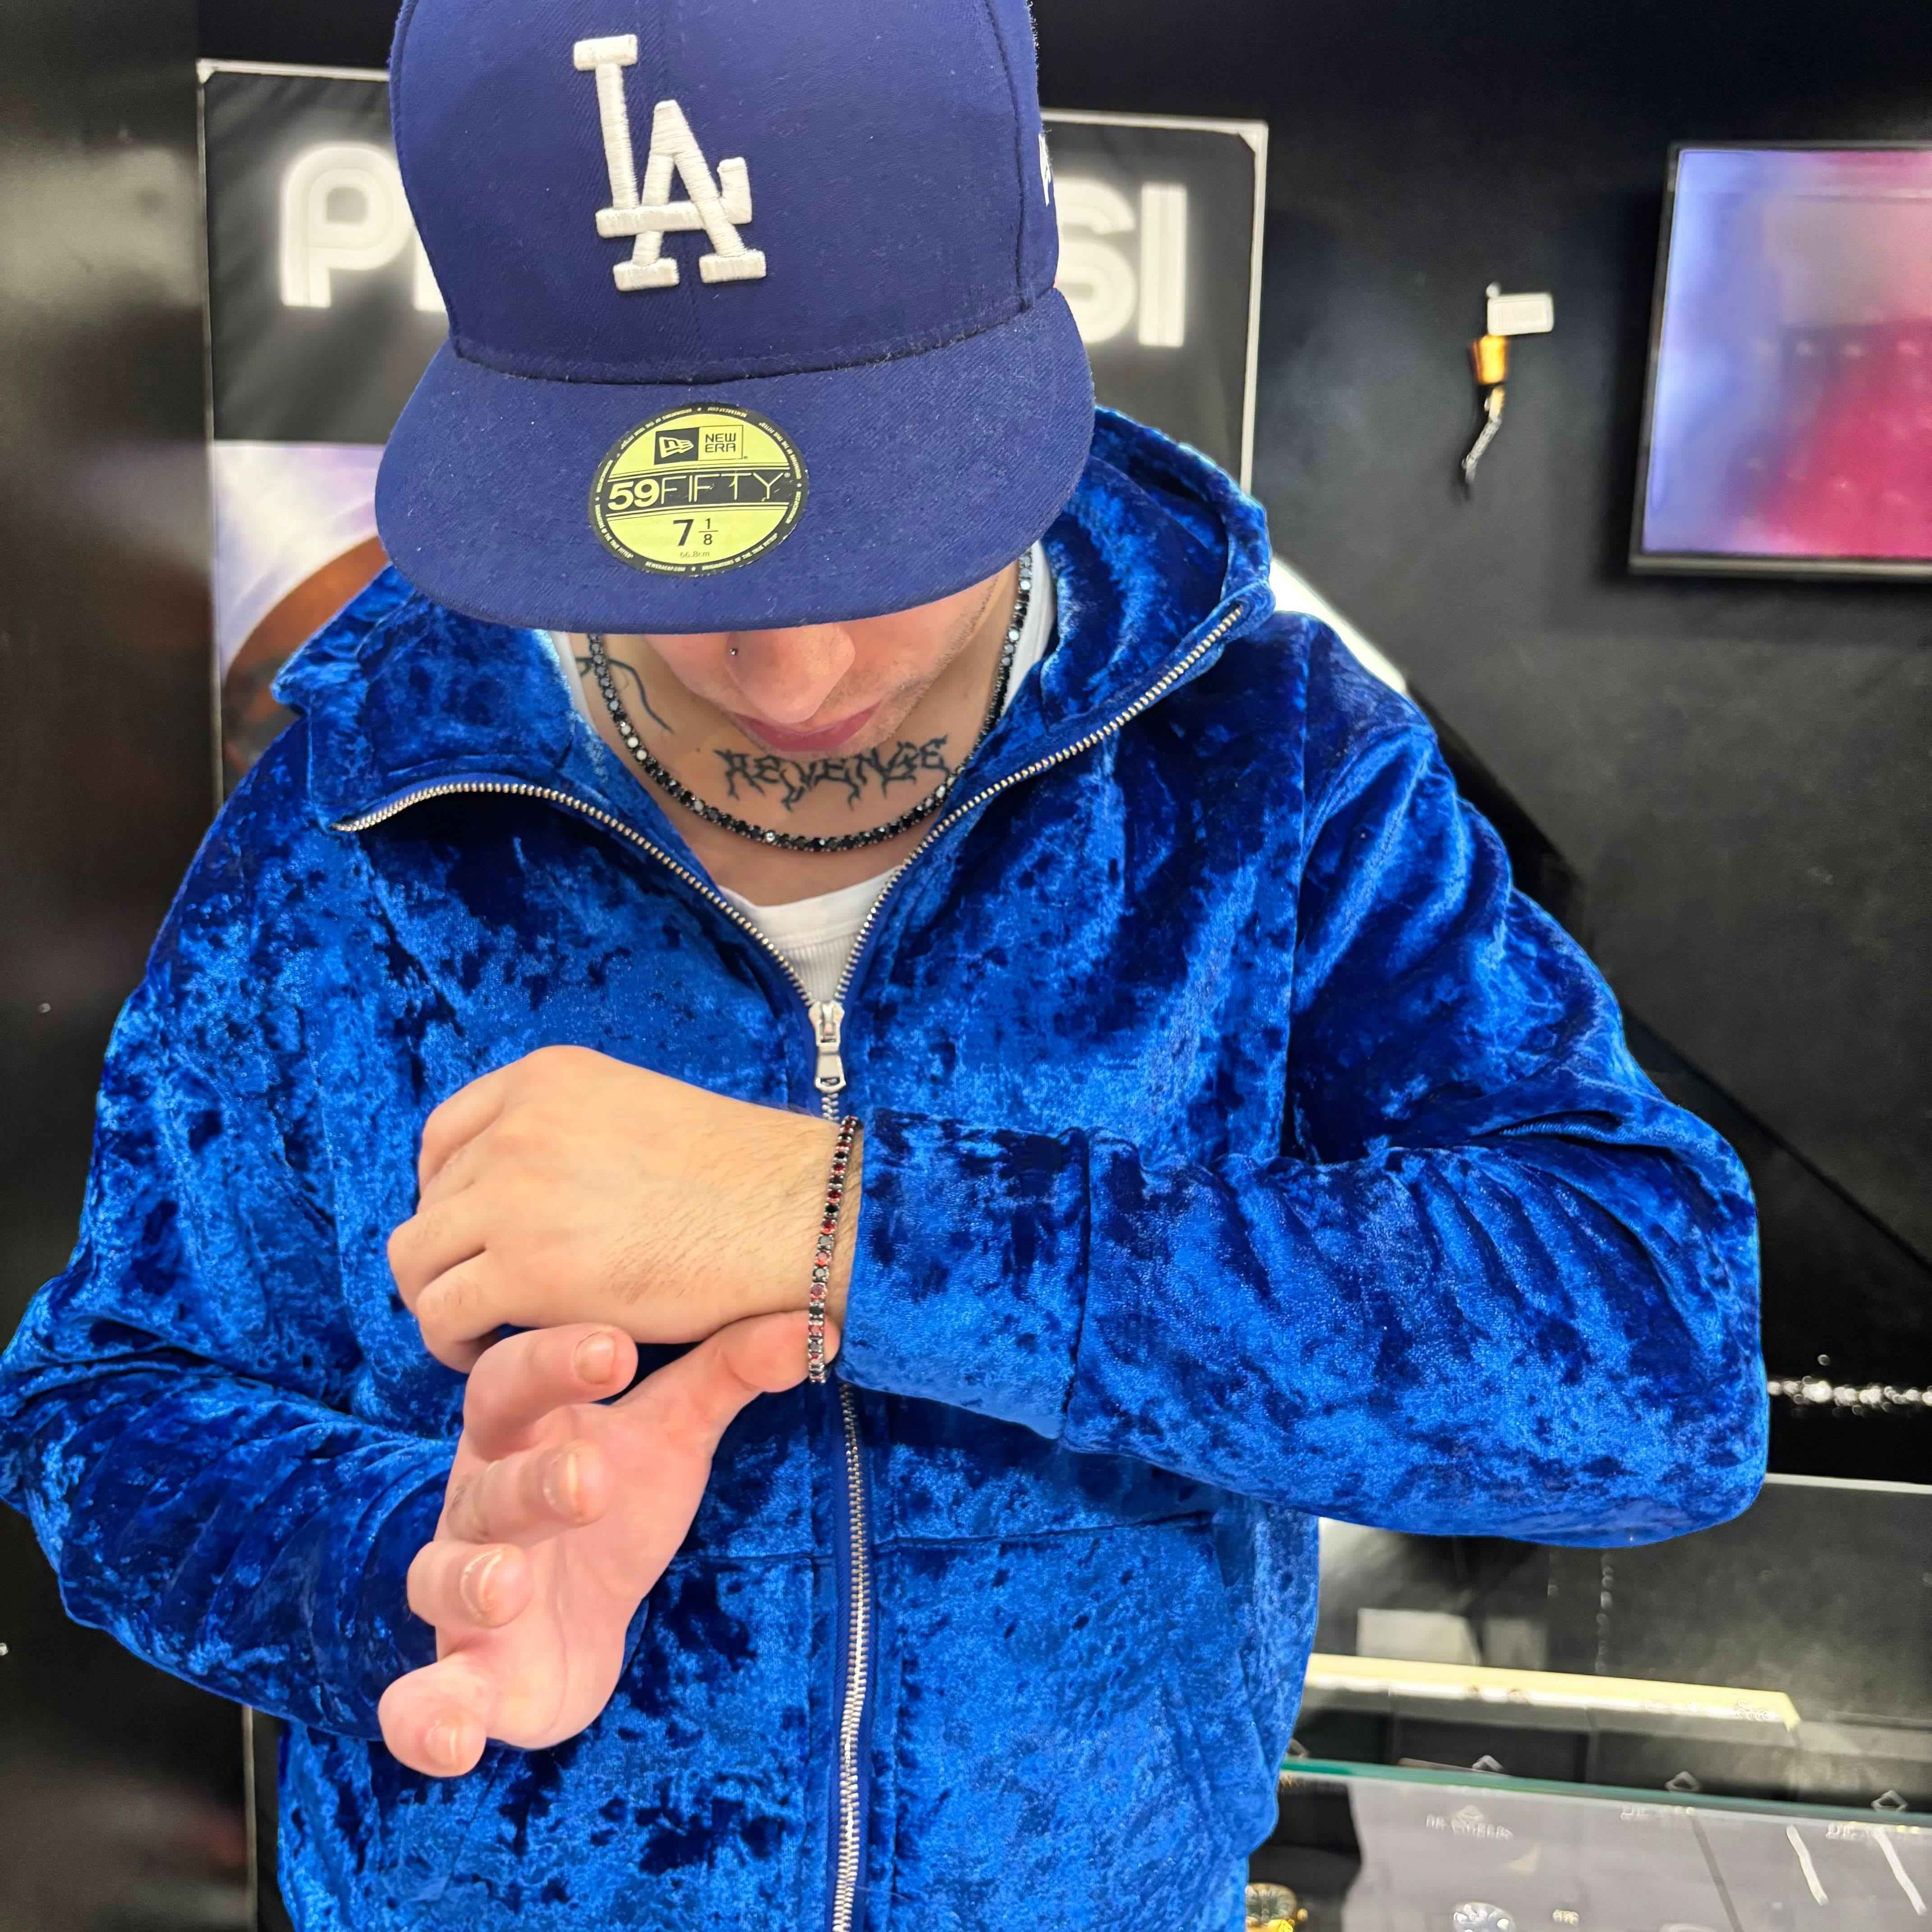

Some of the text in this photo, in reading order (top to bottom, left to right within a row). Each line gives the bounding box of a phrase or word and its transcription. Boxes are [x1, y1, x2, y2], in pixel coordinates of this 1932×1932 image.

[574, 34, 766, 291] LA
[704, 443, 736, 453] ERA
[705, 433, 736, 443] NEW
[673, 519, 694, 547] 7
[713, 735, 951, 812] REVENGE
